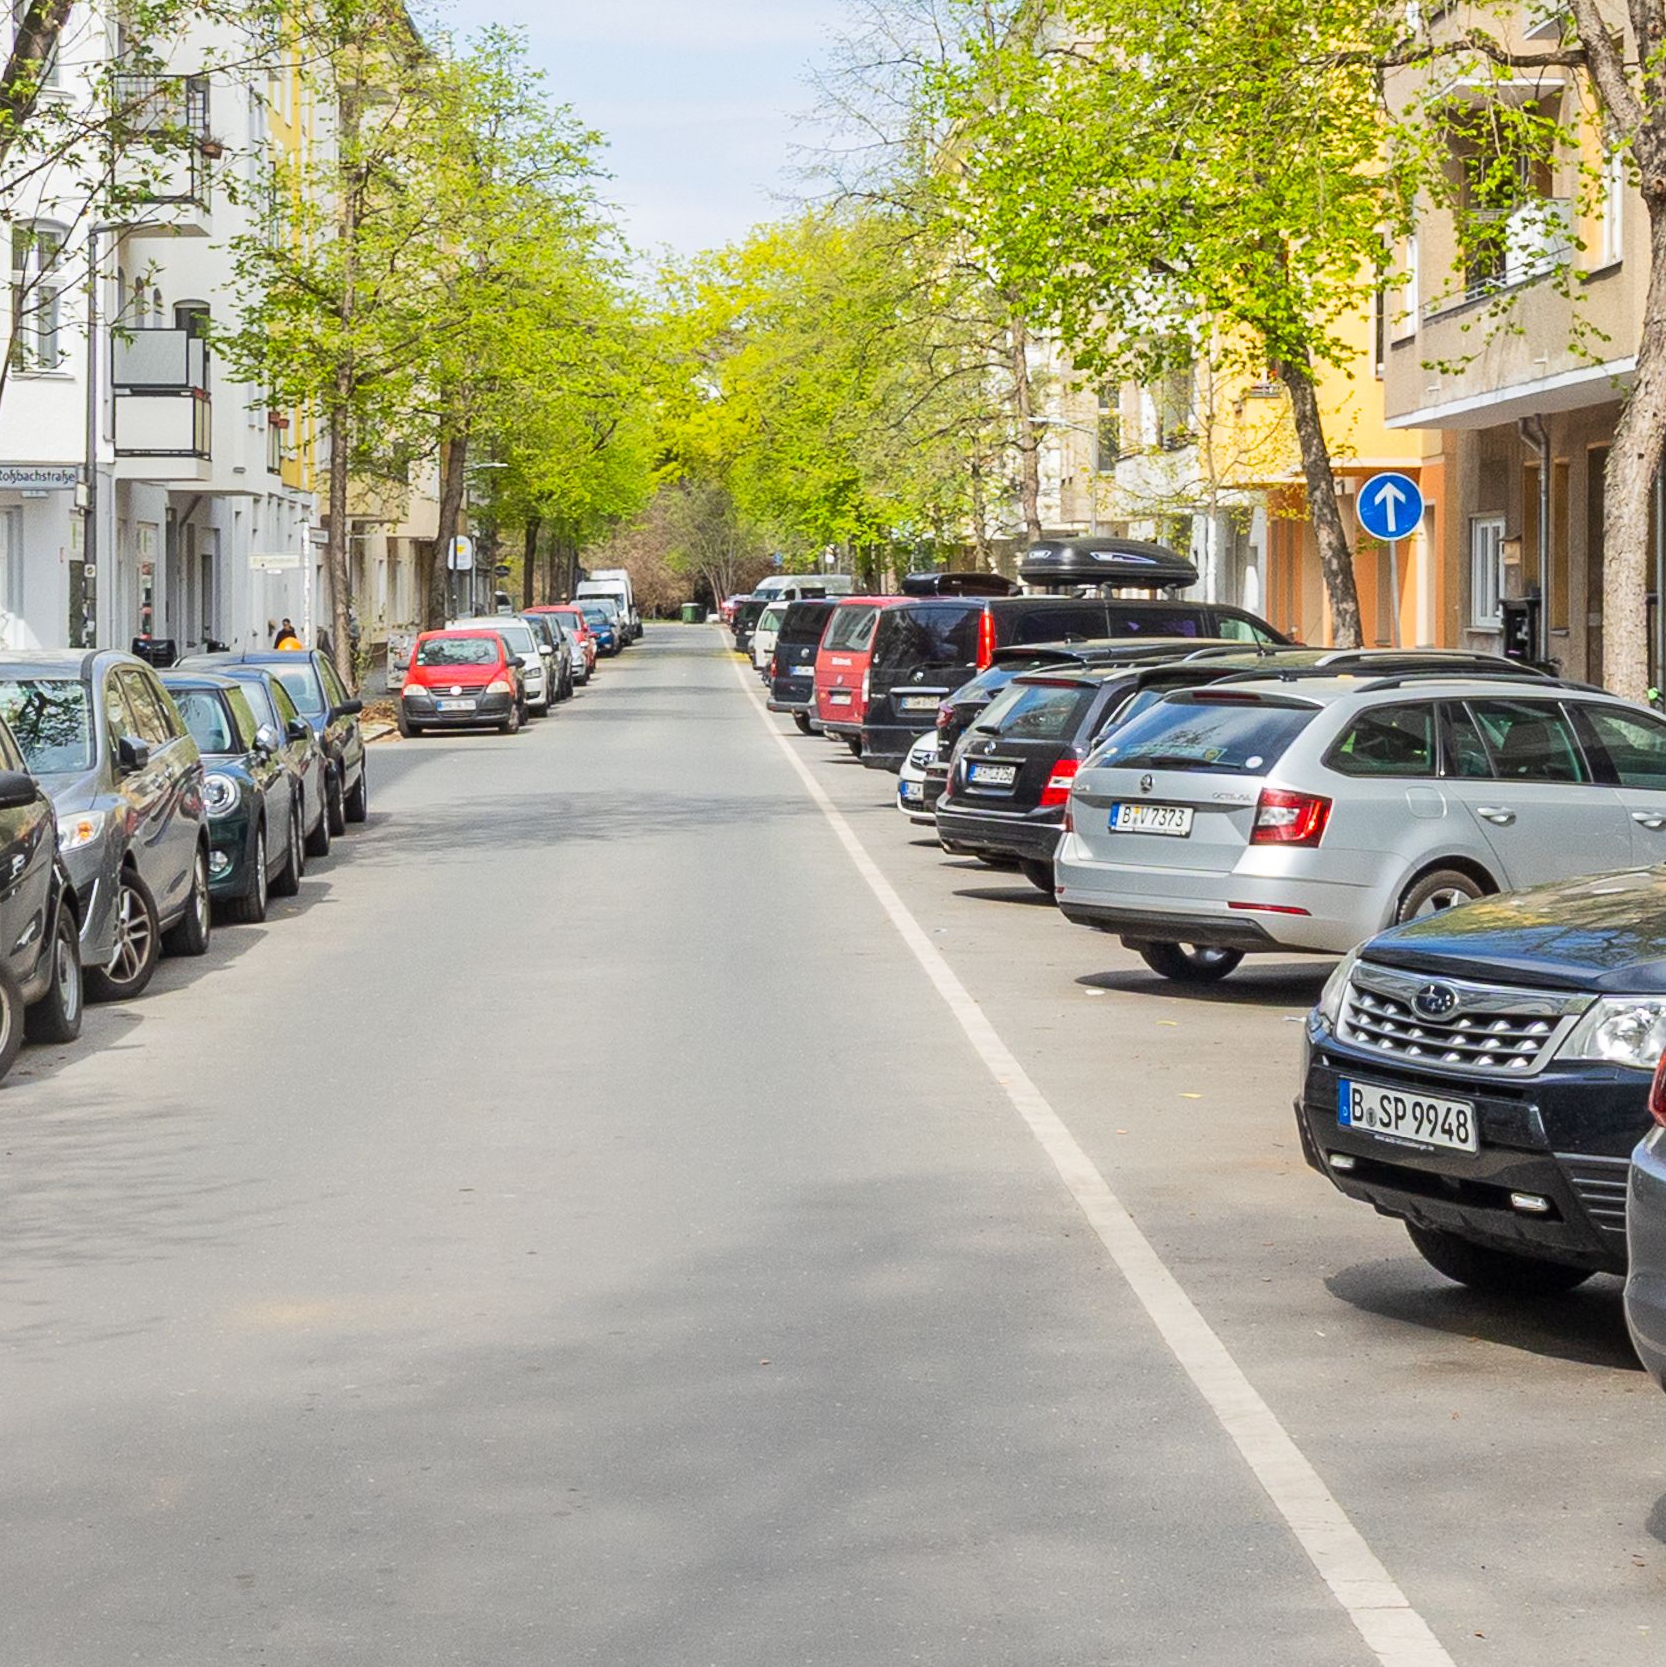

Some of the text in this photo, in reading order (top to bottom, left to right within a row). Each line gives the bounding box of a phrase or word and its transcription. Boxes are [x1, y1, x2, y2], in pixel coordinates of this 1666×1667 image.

[1123, 806, 1185, 827] B V 7373
[1353, 1088, 1364, 1122] B
[1379, 1094, 1407, 1131] SP
[1412, 1101, 1469, 1144] 9948
